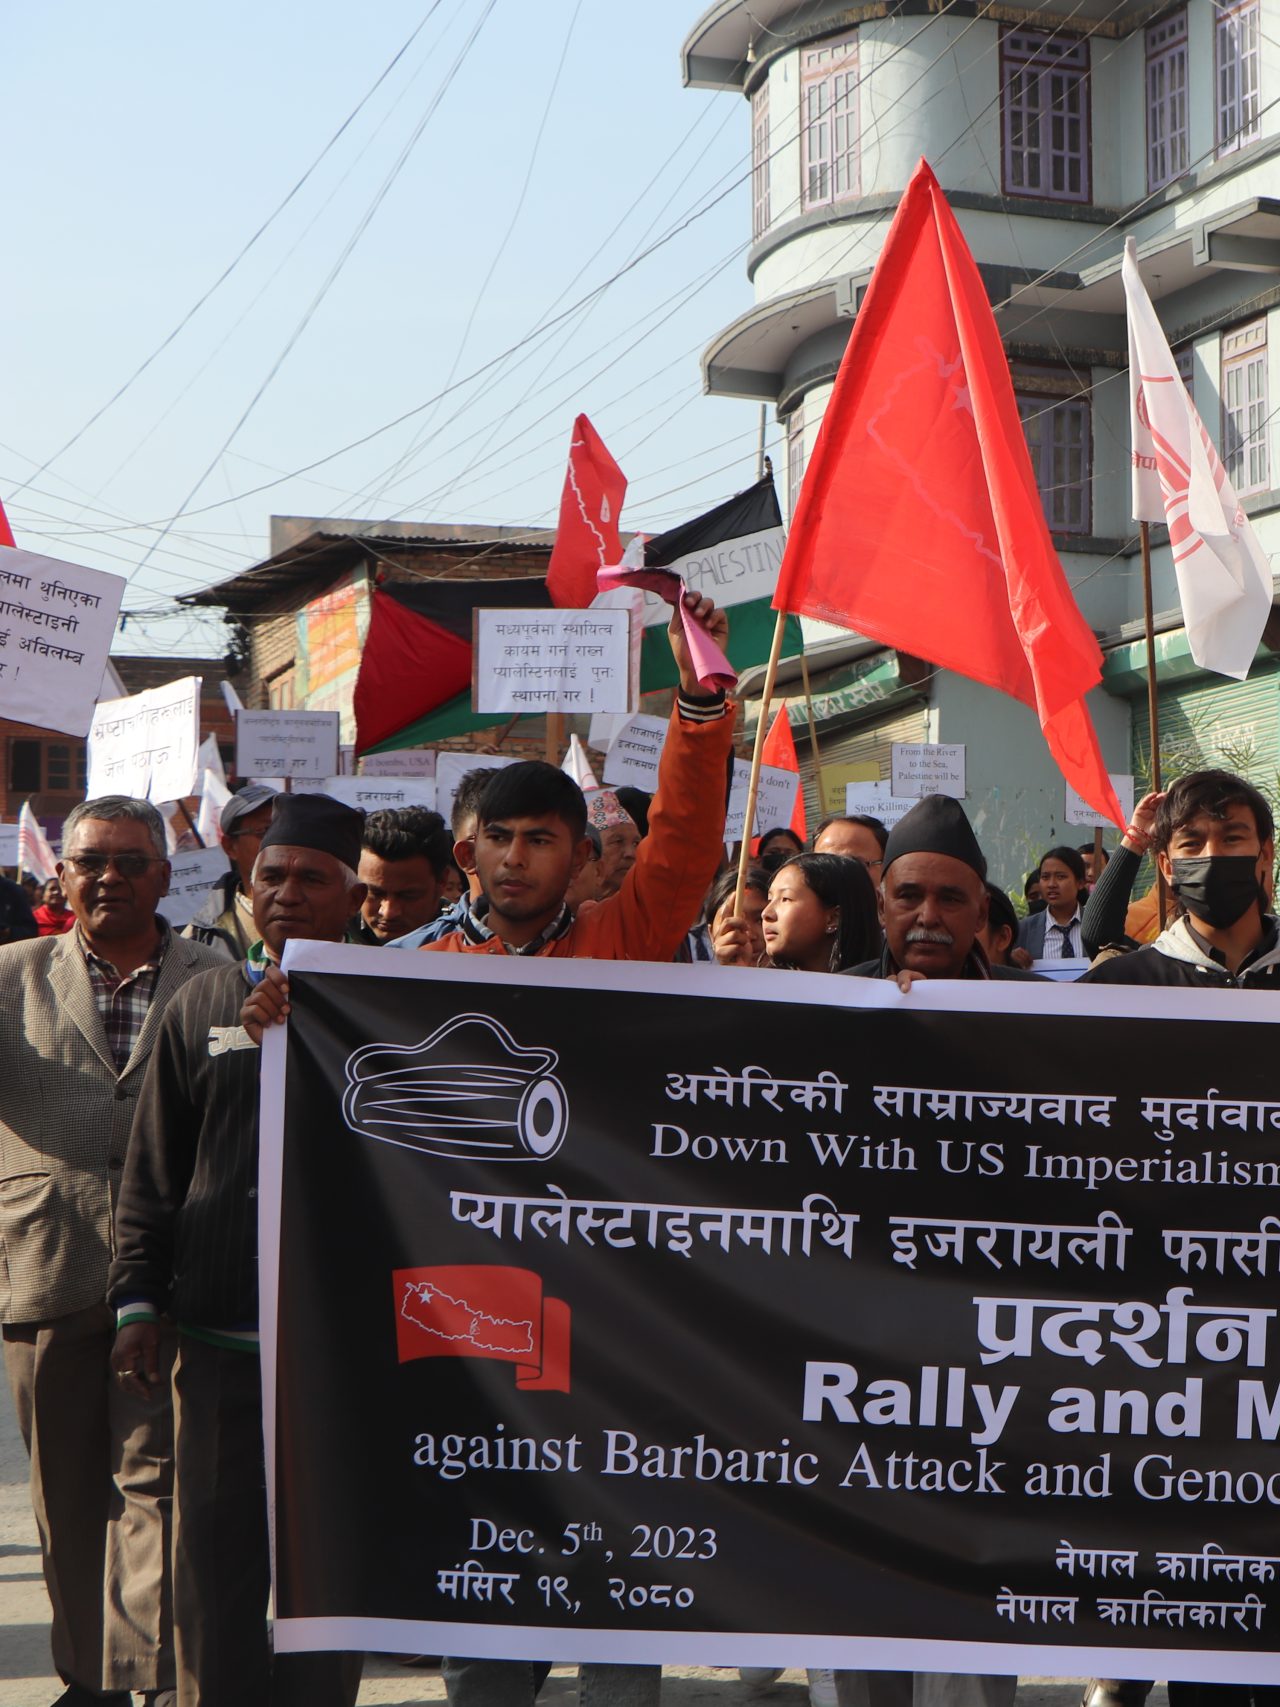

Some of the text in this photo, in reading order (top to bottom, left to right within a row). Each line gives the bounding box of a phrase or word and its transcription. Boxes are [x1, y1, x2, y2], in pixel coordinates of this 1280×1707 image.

[686, 536, 787, 591] PALESTIN
[504, 645, 540, 657] कायम
[564, 690, 582, 702] गर
[900, 747, 957, 756] From the River
[766, 776, 790, 790] don't
[899, 772, 960, 781] Palestine will be
[920, 784, 939, 793] Free!
[759, 805, 778, 817] will
[855, 804, 875, 815] Stop
[666, 1066, 848, 1113] अमेरिकी
[873, 1086, 1116, 1127] साम्राज्यवाद
[650, 1124, 788, 1162] Down
[807, 1133, 917, 1170] With
[937, 1140, 1004, 1175] US
[450, 1184, 860, 1258] प्यालेस्टाइनमाथि
[889, 1211, 1133, 1270] इजरायली
[973, 1287, 1277, 1367] प्रदर्शन
[803, 1361, 1020, 1445] Rally
[1048, 1378, 1202, 1436] and
[414, 1424, 582, 1479] against
[601, 1430, 819, 1484] Barbaric
[839, 1443, 1005, 1493] Attack
[1025, 1453, 1112, 1497] and
[470, 1519, 544, 1553] Dec.
[631, 1525, 716, 1559] 2023
[1056, 1540, 1138, 1578] नेपाल
[437, 1560, 520, 1604] मंसिर
[609, 1578, 694, 1609] २०८०
[997, 1587, 1079, 1624] नेपाल
[1097, 1590, 1266, 1631] क्रान्तिकारी
